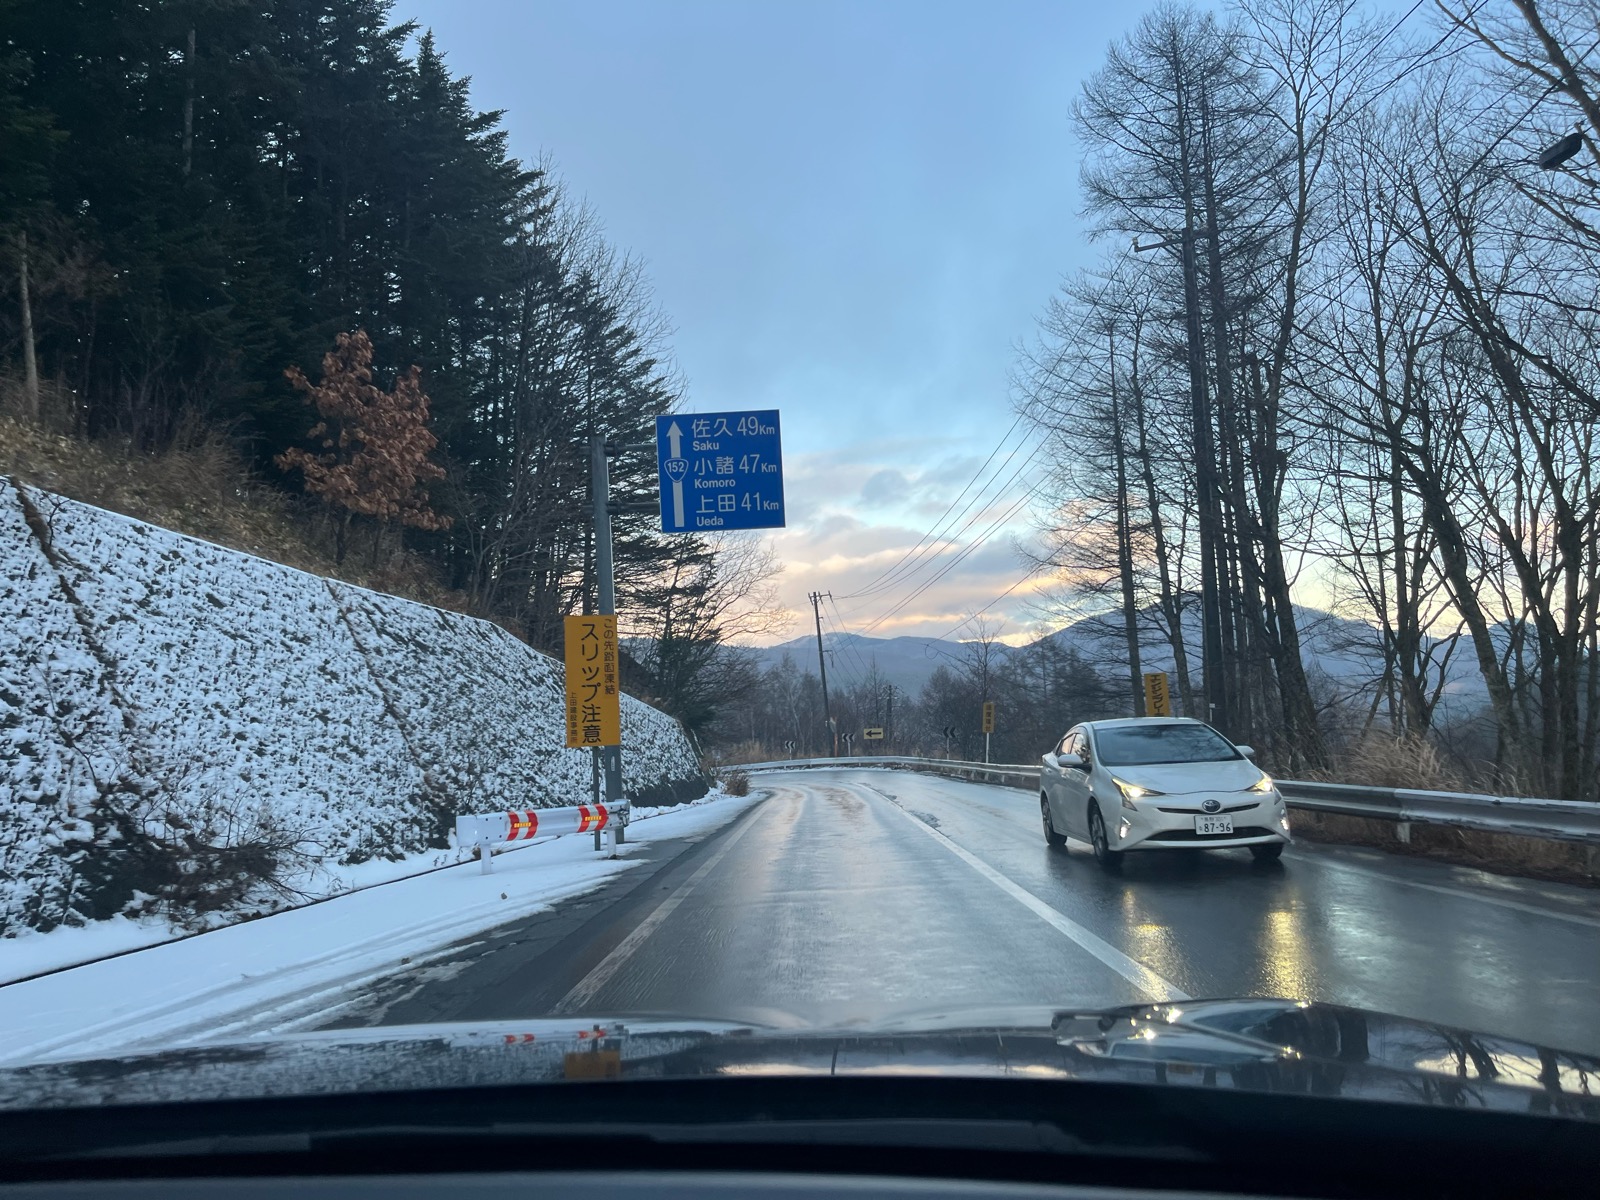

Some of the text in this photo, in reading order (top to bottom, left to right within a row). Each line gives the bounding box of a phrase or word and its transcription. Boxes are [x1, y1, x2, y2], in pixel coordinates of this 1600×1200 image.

[691, 418, 733, 439] 佐久
[692, 440, 720, 452] Saku
[667, 461, 685, 473] 152
[694, 456, 734, 476] 小諸
[694, 478, 736, 489] Komoro
[695, 494, 736, 514] 上田
[696, 516, 724, 527] Ueda
[603, 618, 616, 695] この先路面凍結
[580, 623, 602, 744] スリップ注意
[1204, 822, 1231, 833] 87-96
